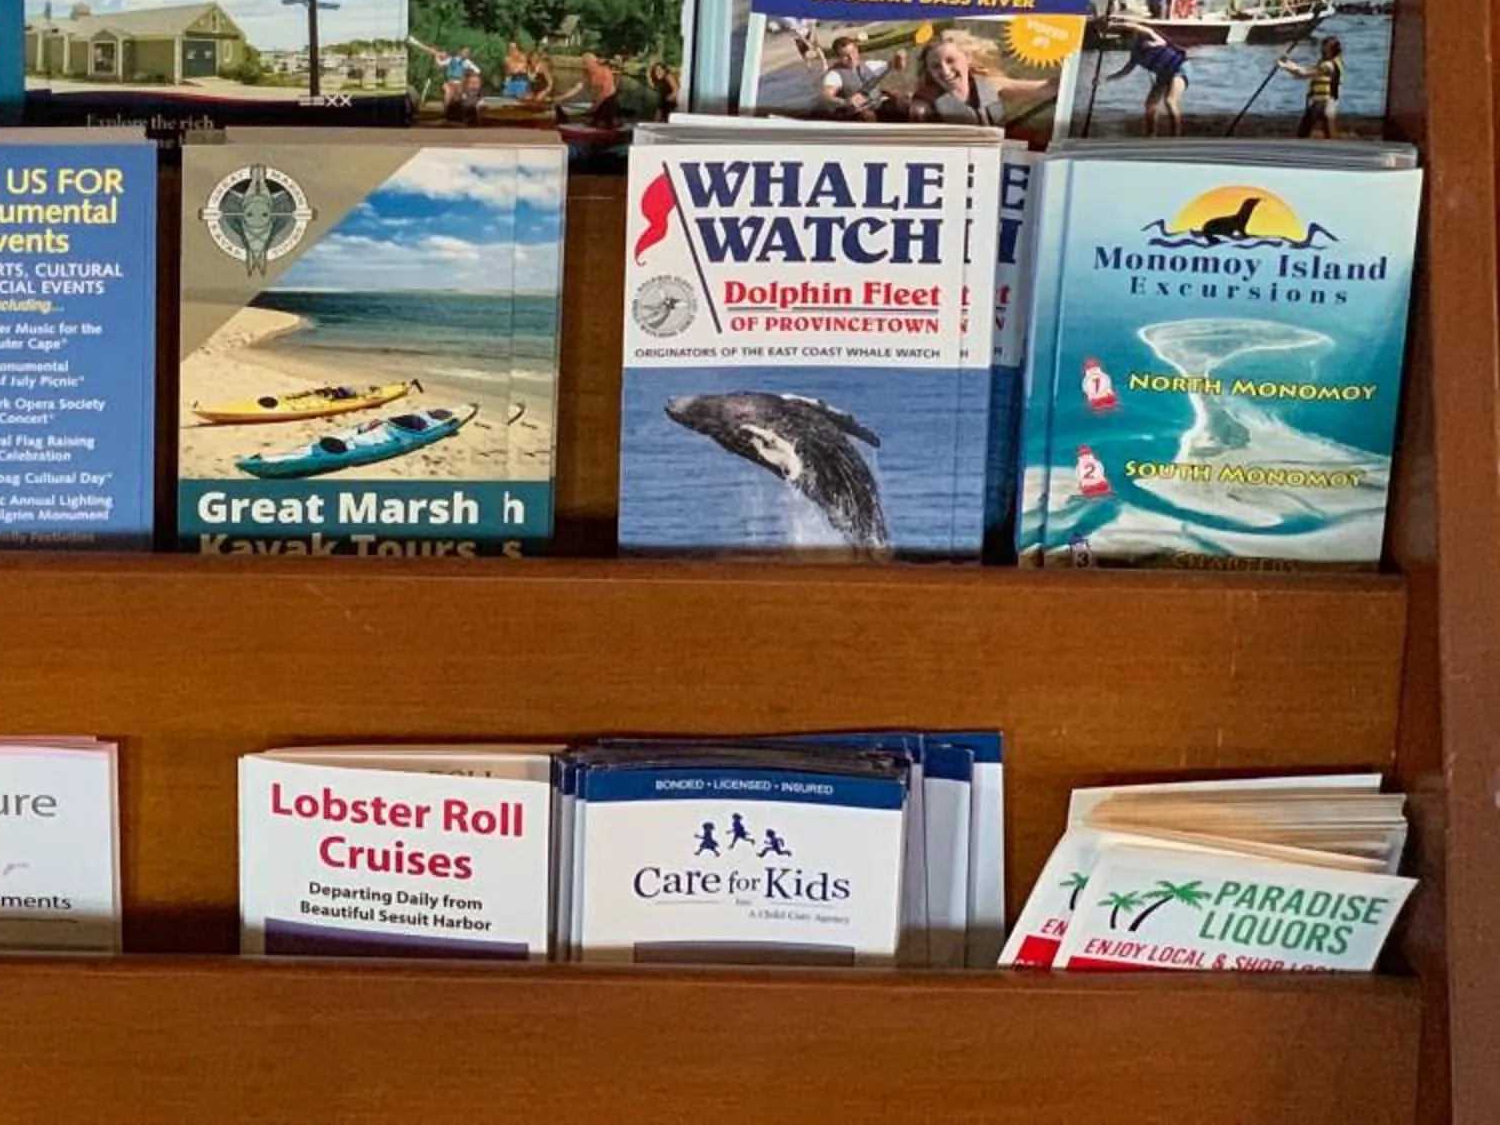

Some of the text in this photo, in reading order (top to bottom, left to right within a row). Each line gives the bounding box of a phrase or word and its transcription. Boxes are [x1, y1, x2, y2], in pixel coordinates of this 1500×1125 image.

[8, 170, 47, 194] US
[58, 169, 123, 194] FOR
[680, 162, 944, 208] WHALE
[696, 217, 942, 264] WATCH
[1095, 247, 1386, 281] Monomoy Island
[724, 282, 853, 308] Dolphin
[862, 282, 941, 306] Fleet
[1130, 277, 1348, 304] Excursions
[731, 317, 939, 333] OF PROVINCETOWN
[1128, 374, 1376, 400] NORTH MONOMOY
[1125, 461, 1365, 486] SOUTH MONOMOY
[198, 492, 478, 525] Great Marsh
[271, 783, 524, 837] Lobster Roll
[319, 837, 473, 879] Cruises
[309, 881, 483, 911] Departing Daily from
[633, 869, 851, 902] Care for Kids
[300, 902, 491, 933] Beautiful Sesuit Harbor
[1213, 881, 1390, 925] PARADISE
[1198, 910, 1350, 956] LIQUORS
